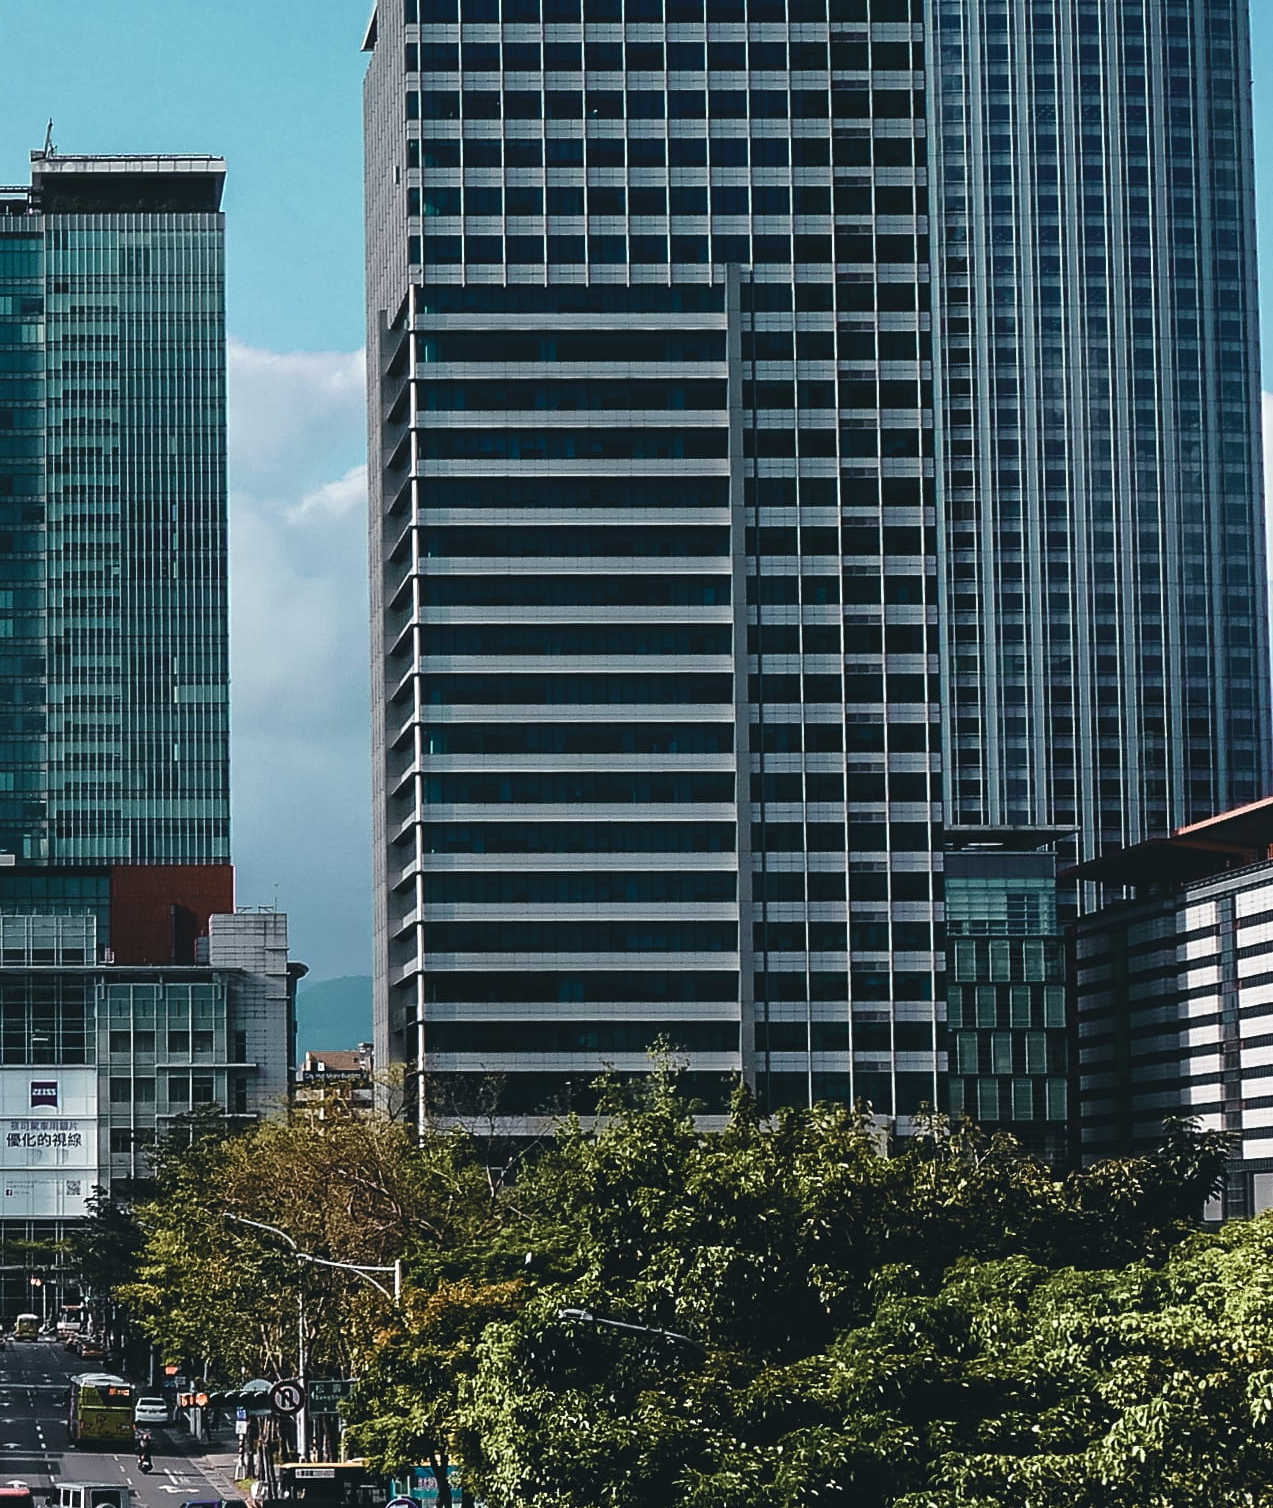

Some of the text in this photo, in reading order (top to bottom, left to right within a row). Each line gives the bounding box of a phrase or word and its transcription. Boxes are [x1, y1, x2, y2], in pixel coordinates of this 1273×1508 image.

[6, 1132, 82, 1148] 優化的視線
